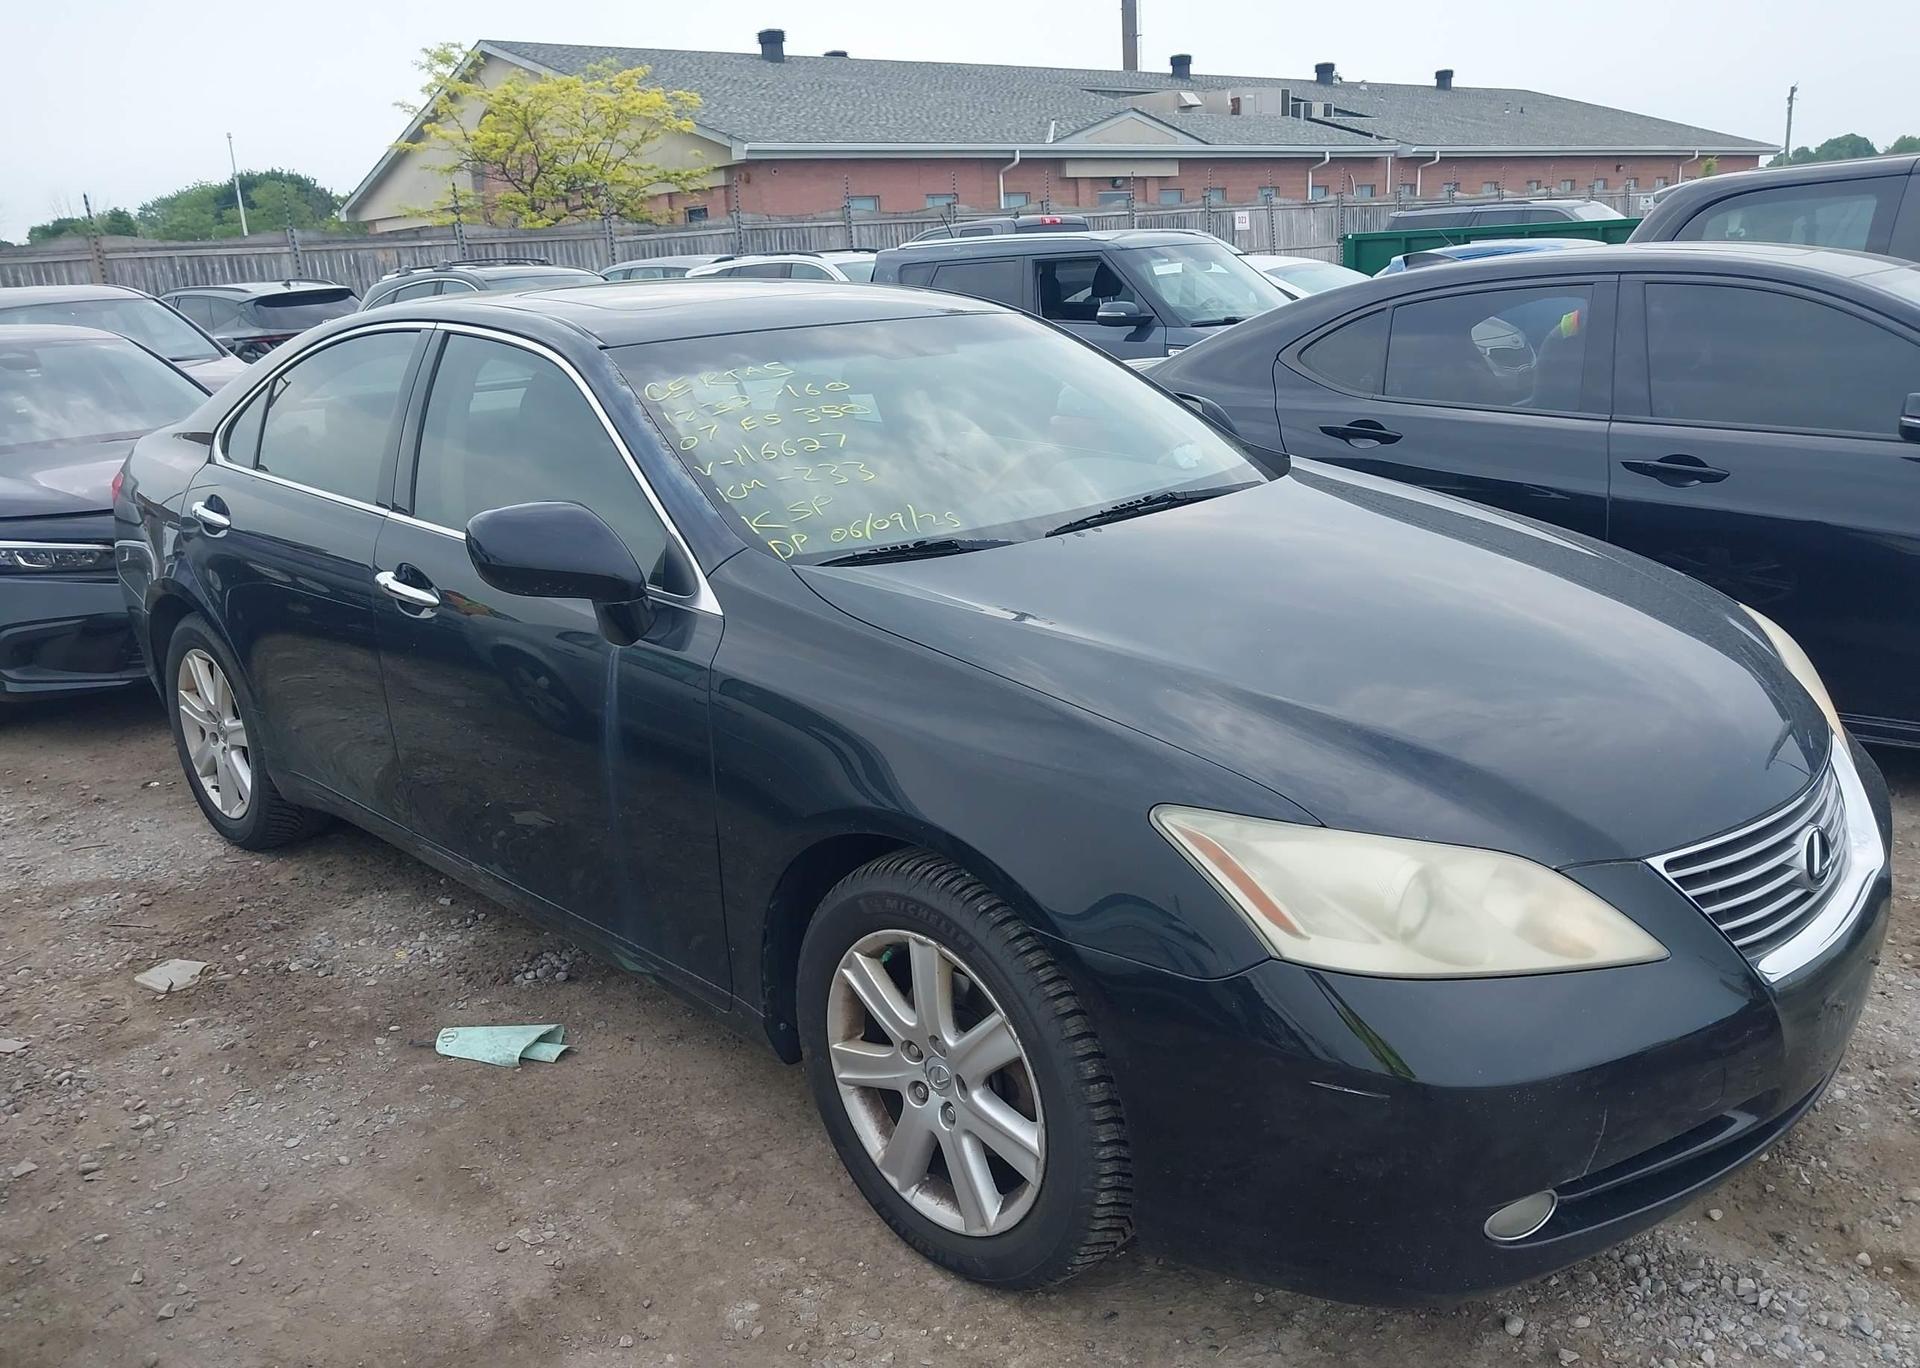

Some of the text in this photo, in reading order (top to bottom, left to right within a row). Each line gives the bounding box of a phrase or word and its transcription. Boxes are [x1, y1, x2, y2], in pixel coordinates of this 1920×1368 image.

[644, 361, 796, 402] CERTAS
[680, 424, 718, 450] 07
[792, 403, 872, 424] 350
[767, 533, 809, 562] DP
